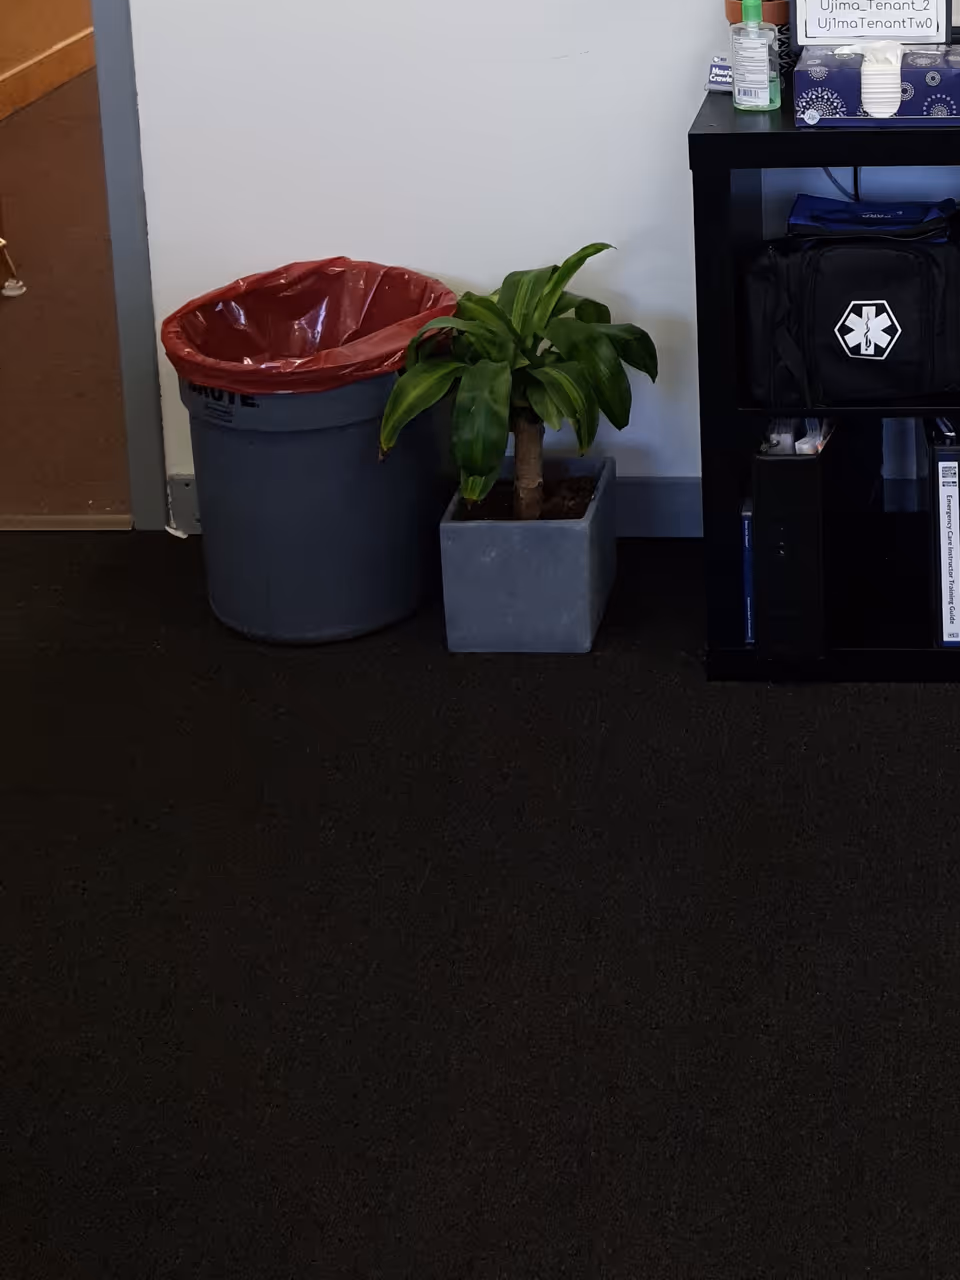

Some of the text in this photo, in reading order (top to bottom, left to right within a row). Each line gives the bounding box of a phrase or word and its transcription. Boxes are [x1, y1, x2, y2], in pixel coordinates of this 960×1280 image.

[820, 0, 930, 14] Ujima_Tenant_2
[947, 546, 955, 578] Instructor
[948, 579, 956, 605] Training
